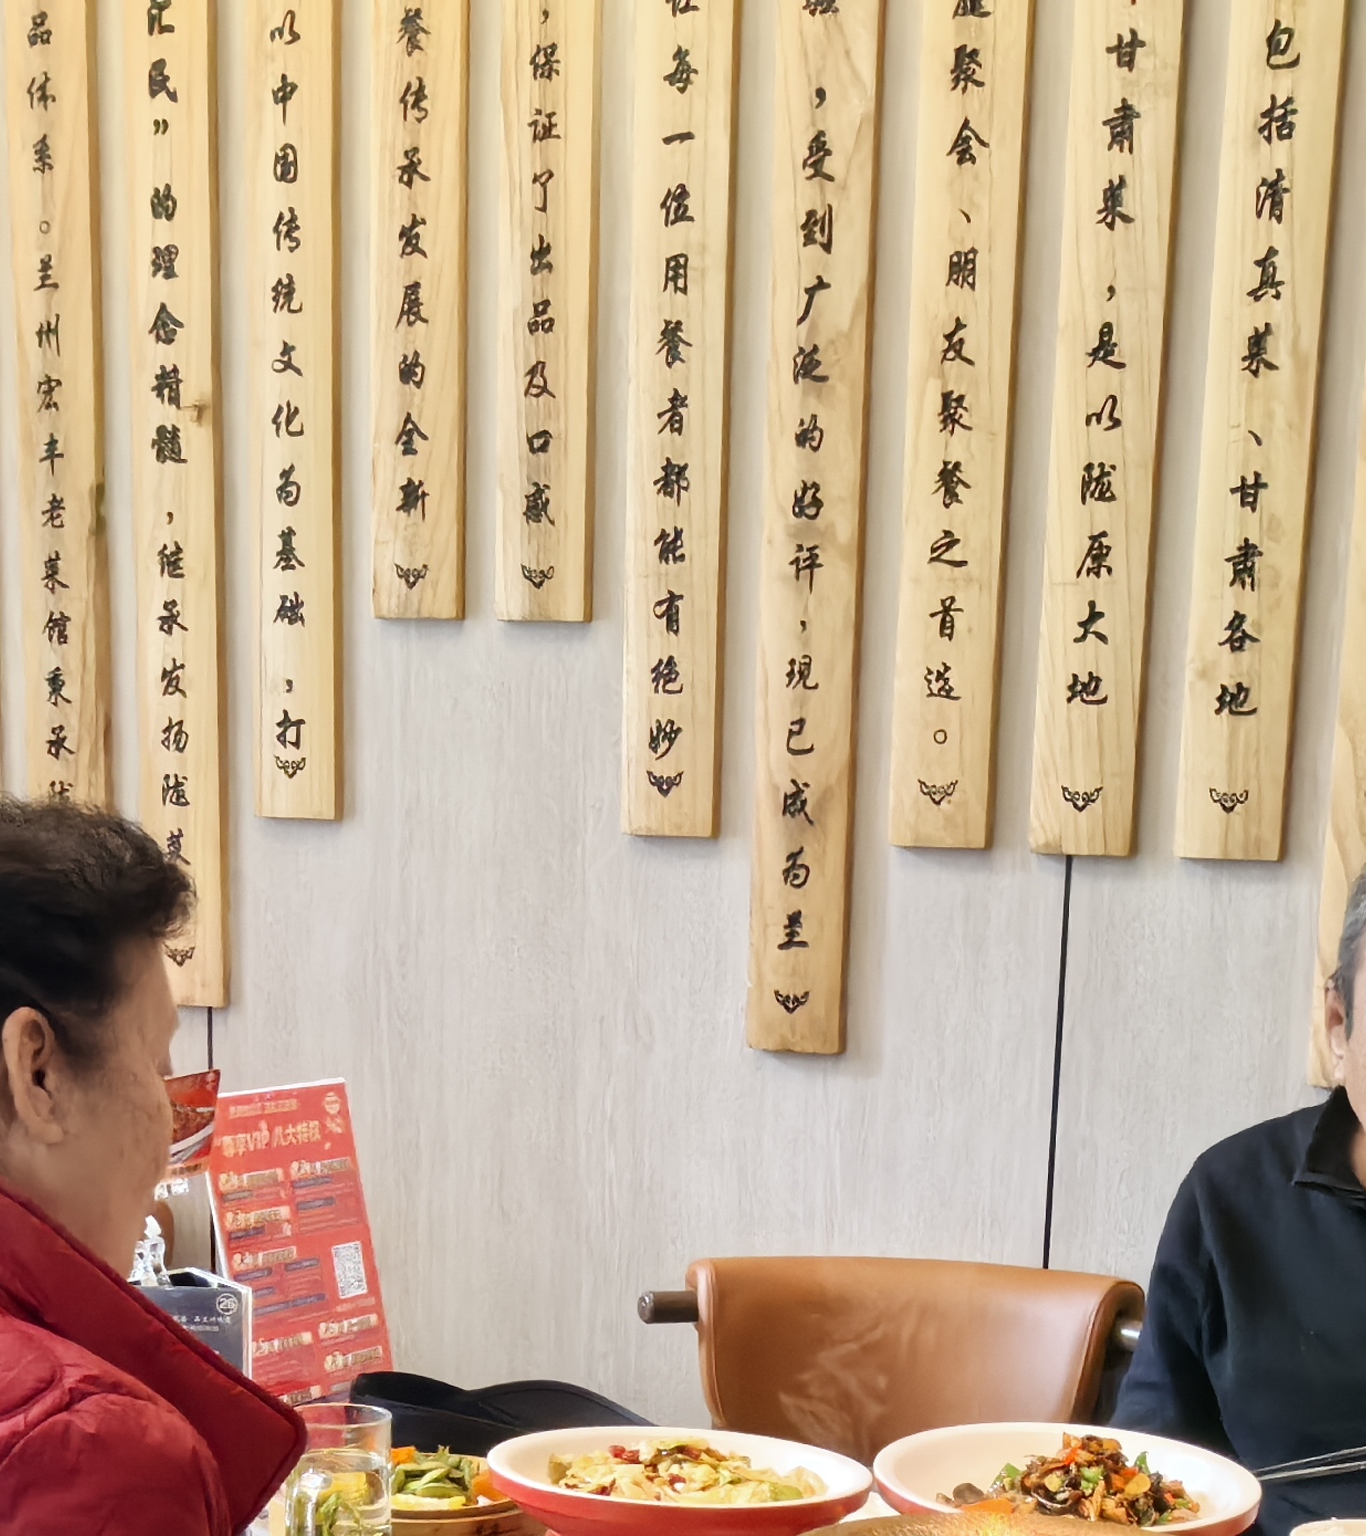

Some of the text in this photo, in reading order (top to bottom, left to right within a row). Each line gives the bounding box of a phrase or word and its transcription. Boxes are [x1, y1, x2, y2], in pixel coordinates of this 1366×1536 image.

[394, 5, 433, 521] 餐传承发展的全新
